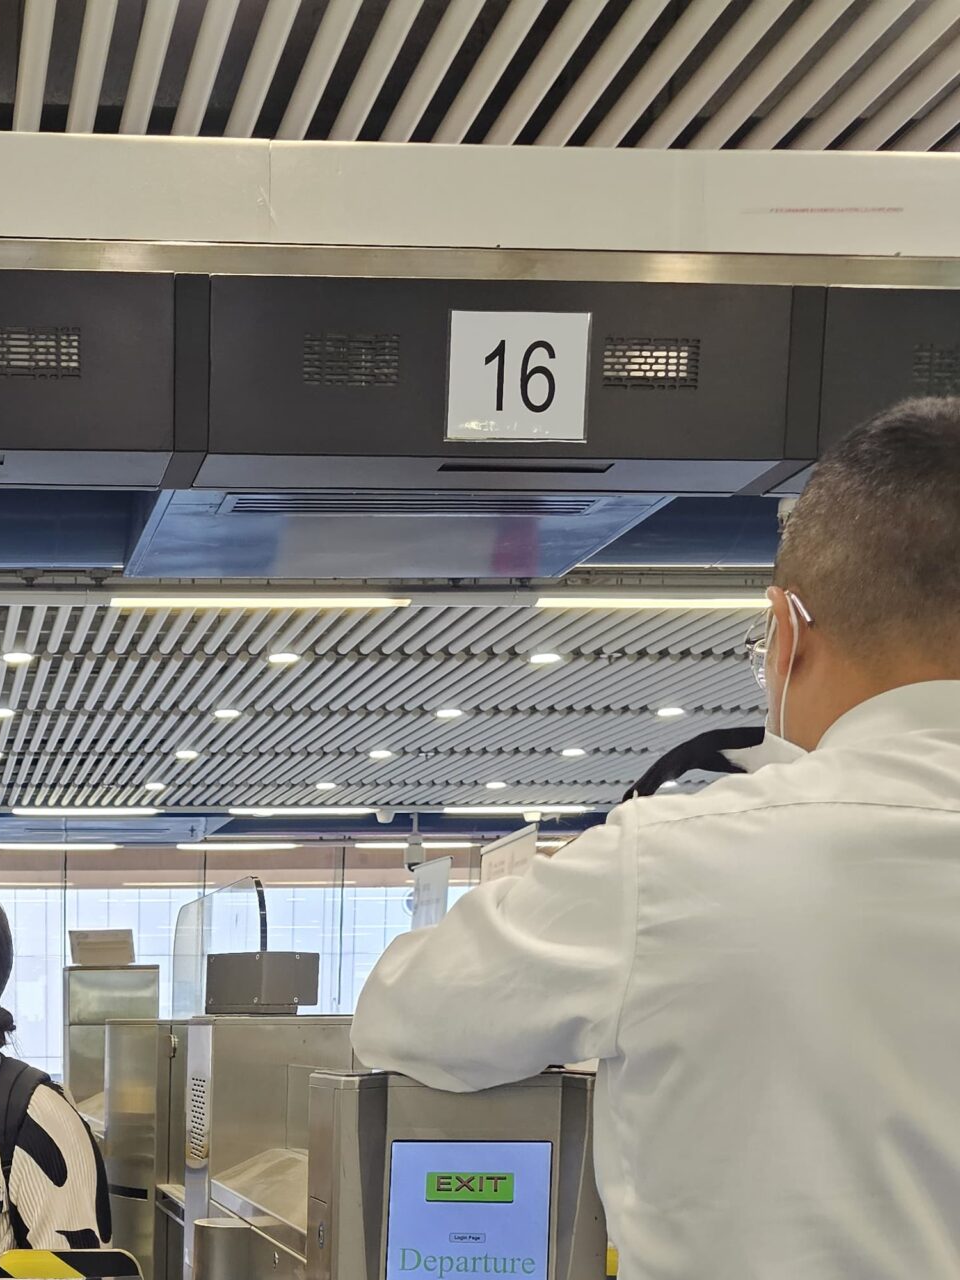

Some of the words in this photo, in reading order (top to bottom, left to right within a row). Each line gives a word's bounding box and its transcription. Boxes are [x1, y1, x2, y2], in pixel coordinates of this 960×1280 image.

[484, 339, 556, 413] 16
[436, 1175, 507, 1192] EXIT
[399, 1247, 536, 1279] Departure
